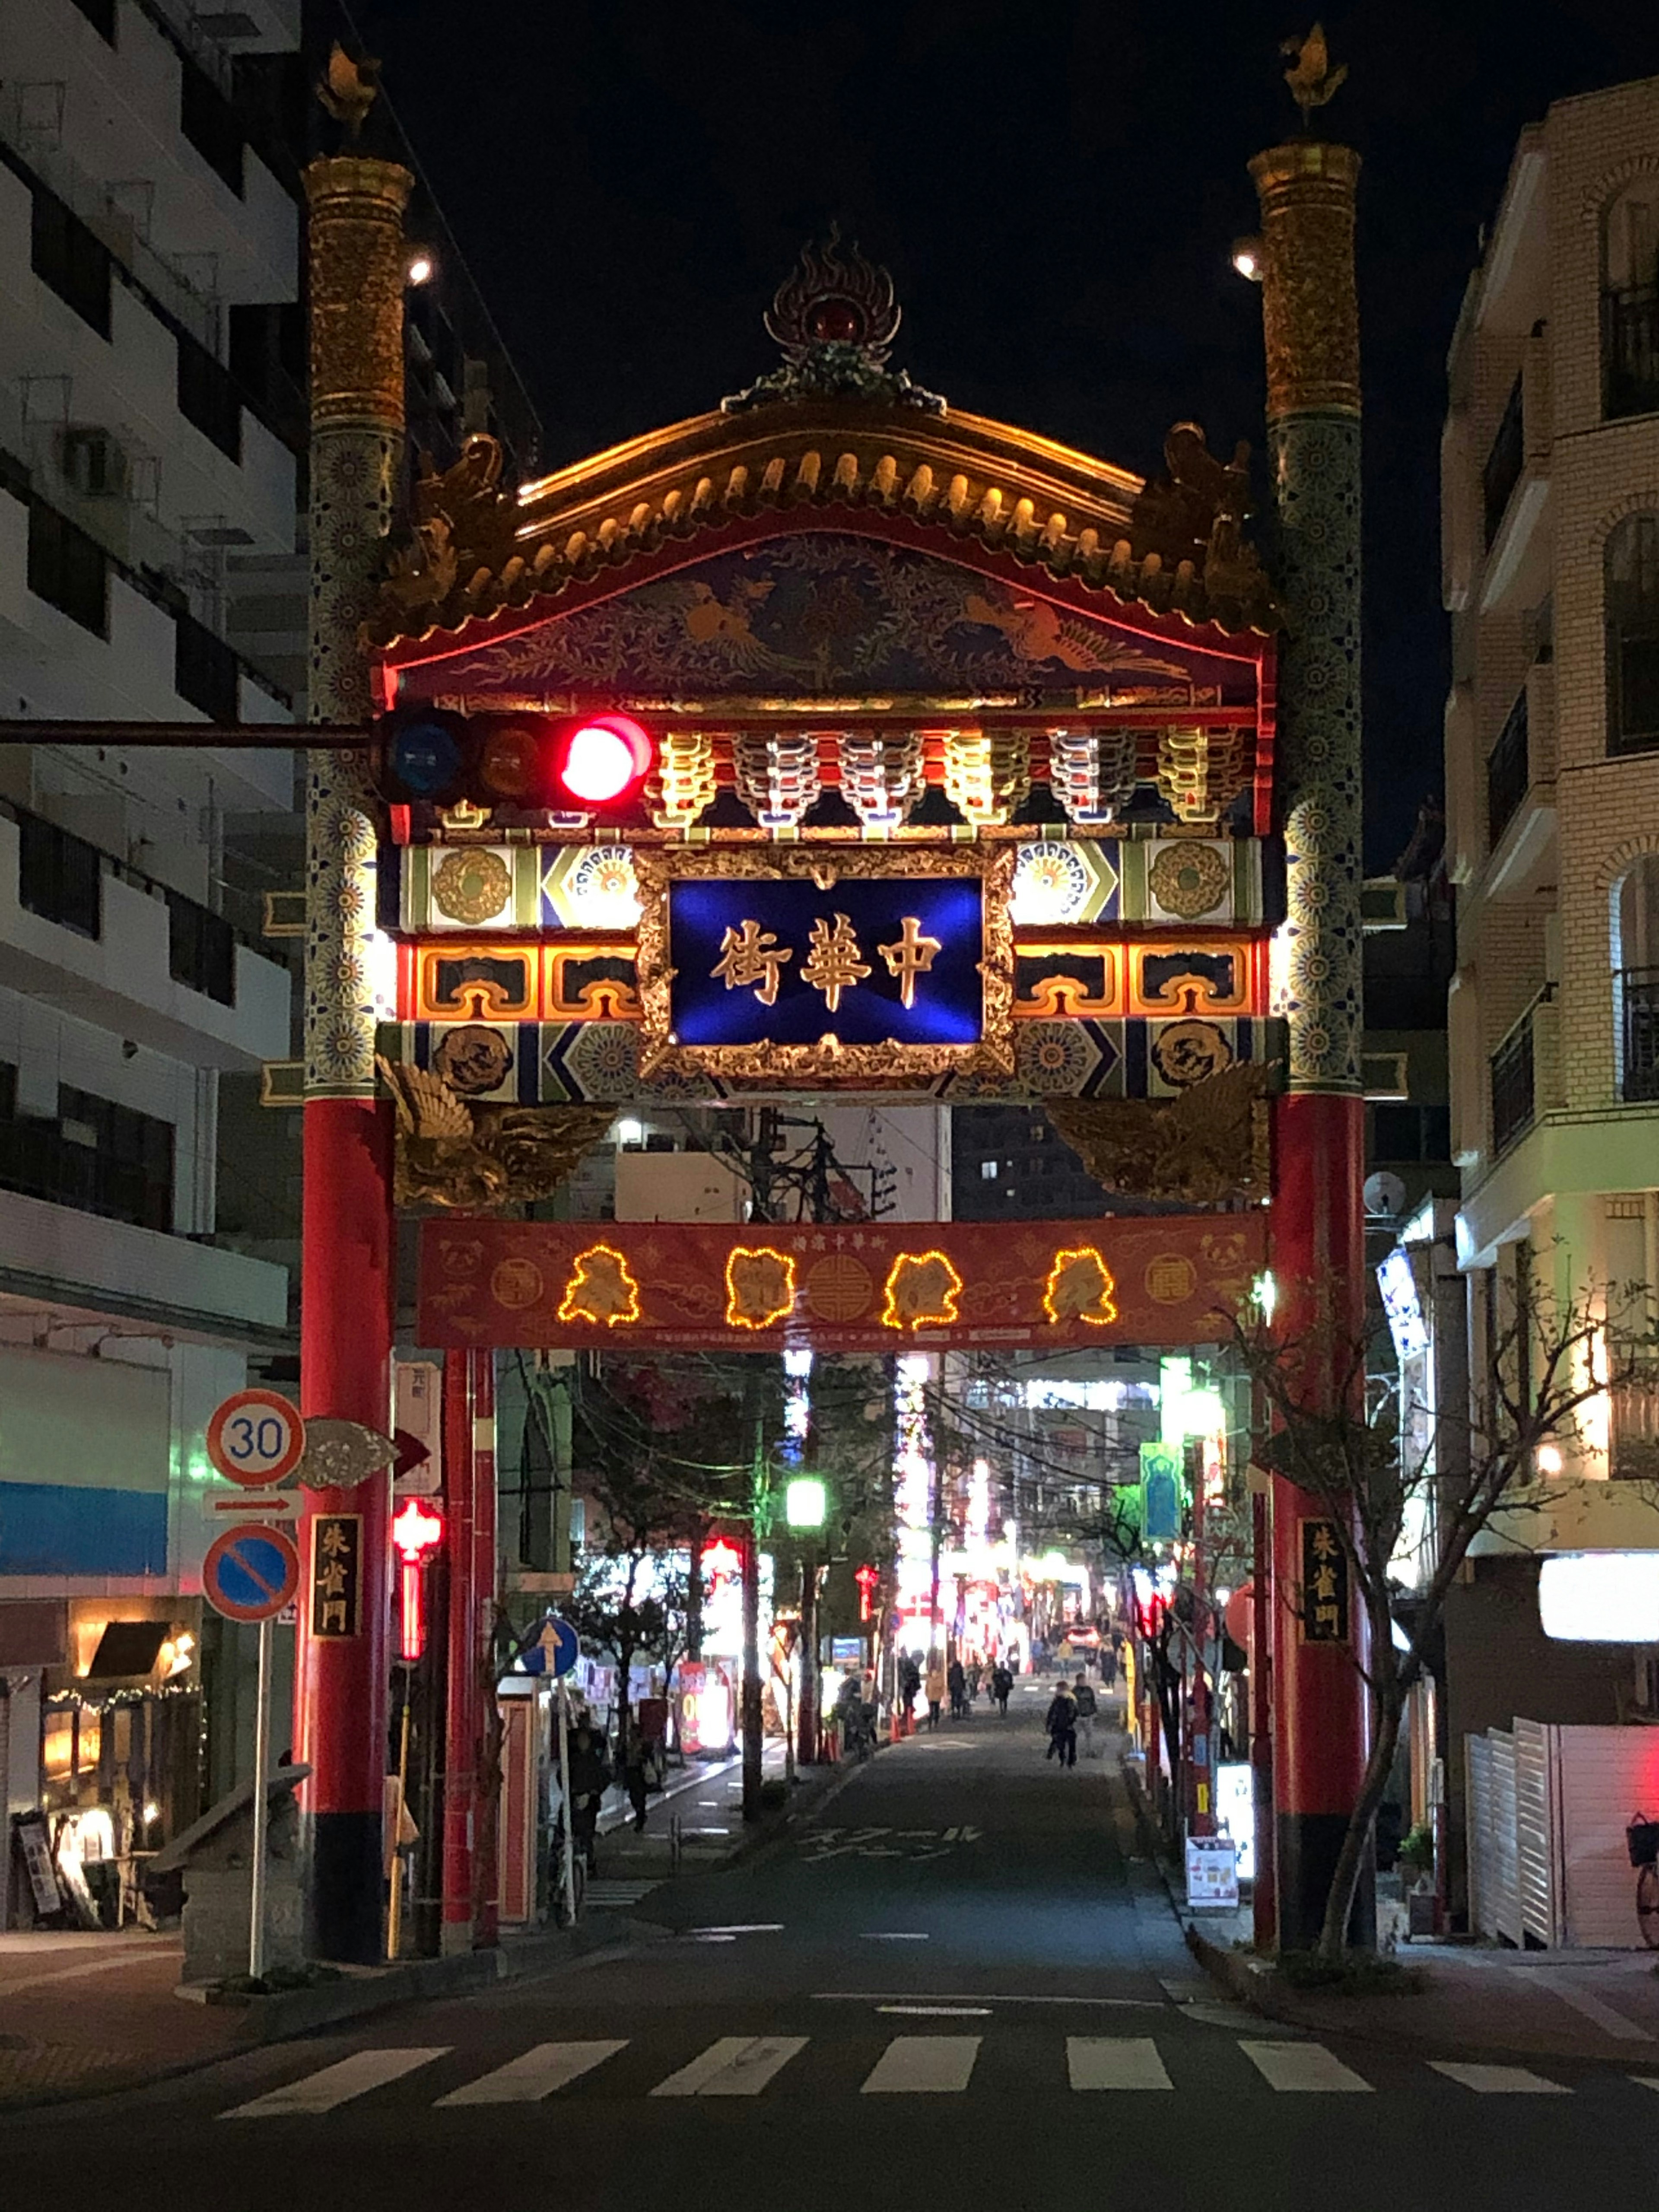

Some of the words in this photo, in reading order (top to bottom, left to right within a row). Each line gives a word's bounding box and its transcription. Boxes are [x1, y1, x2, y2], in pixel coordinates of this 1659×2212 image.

[710, 912, 942, 1013] 中華街
[230, 1417, 283, 1459] 30
[316, 1522, 351, 1633] 朱雀門
[1307, 1525, 1340, 1636] 朱雀門
